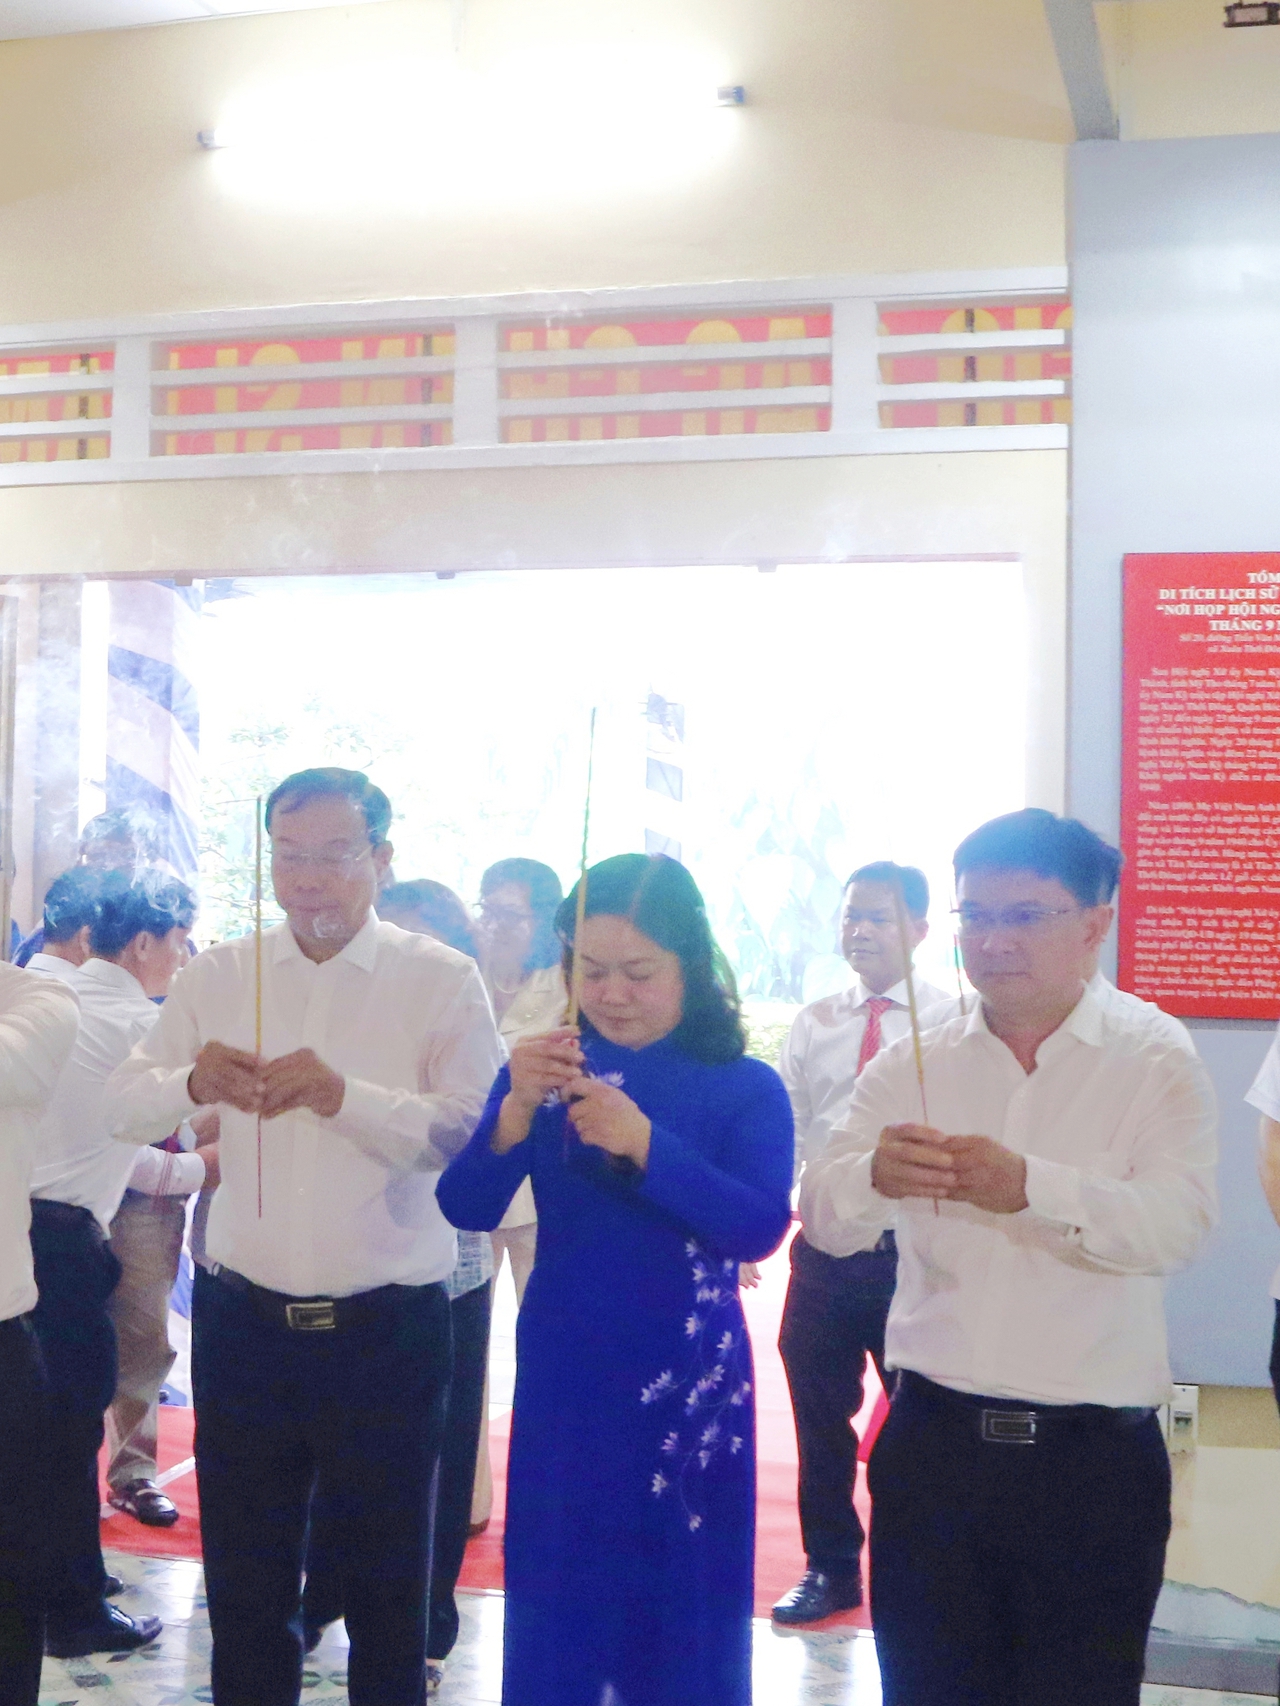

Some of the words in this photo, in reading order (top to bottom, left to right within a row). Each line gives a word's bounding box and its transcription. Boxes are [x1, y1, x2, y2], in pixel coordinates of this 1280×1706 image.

[1159, 588, 1176, 599] DI
[1179, 586, 1216, 599] TÍCH
[1219, 588, 1256, 601] LỊCH
[1194, 604, 1226, 617] HỌP
[1228, 602, 1256, 616] HỘI
[1209, 617, 1262, 631] THÁNG
[1265, 620, 1274, 630] 9
